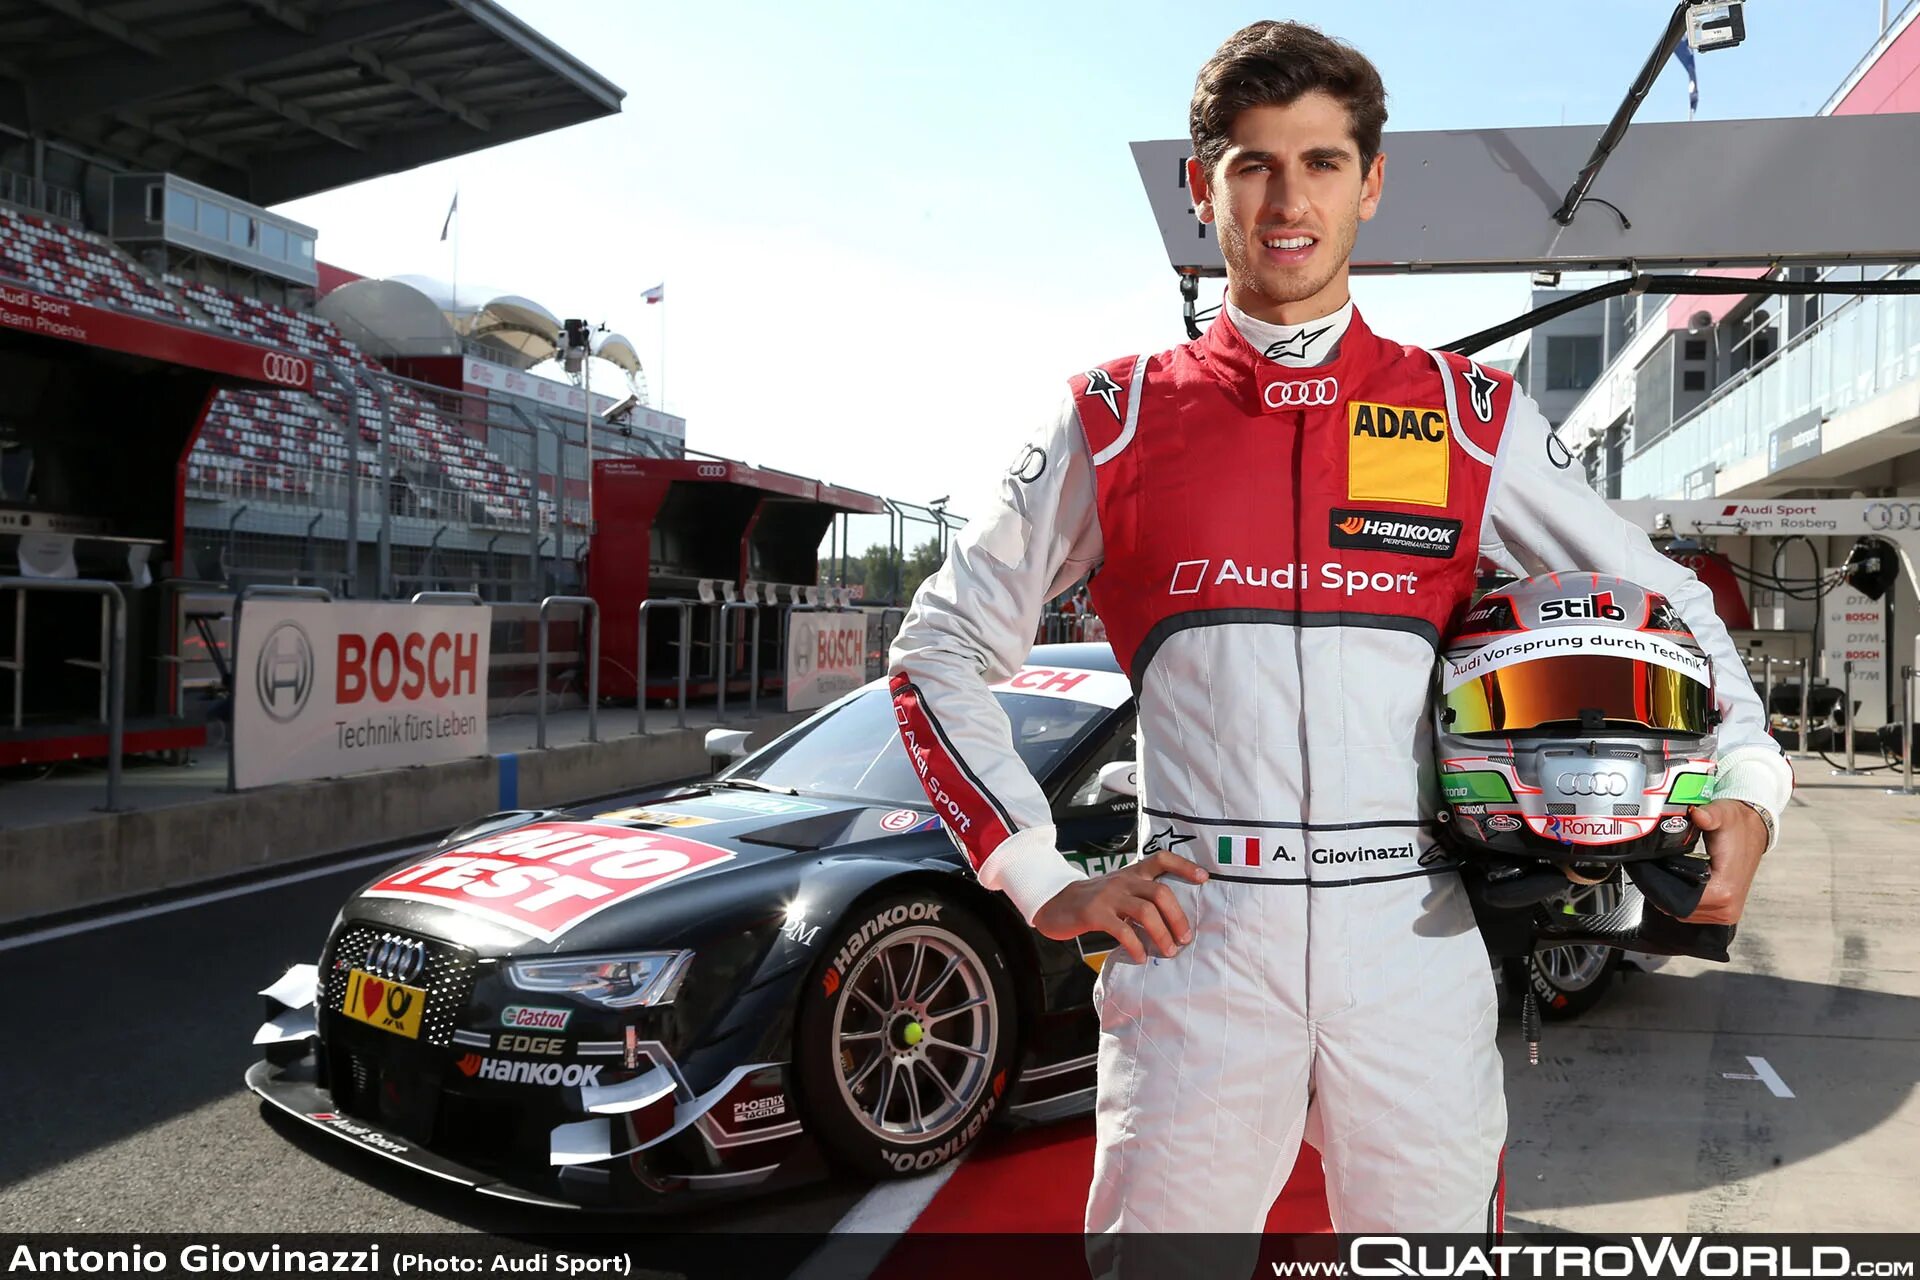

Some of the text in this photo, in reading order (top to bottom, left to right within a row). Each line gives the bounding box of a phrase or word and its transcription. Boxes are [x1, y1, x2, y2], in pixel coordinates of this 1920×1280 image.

[32, 295, 71, 317] Sport
[36, 316, 87, 340] Phoenix
[1353, 405, 1445, 442] ADAC
[1740, 504, 1816, 517] Audi Sport
[1781, 518, 1837, 529] Rosberg
[1215, 559, 1418, 596] Audi Sport
[1540, 591, 1625, 621] Stilo
[1845, 613, 1879, 622] BOSCH
[817, 629, 863, 669] BOSCH
[1847, 633, 1879, 643] DTM
[1452, 635, 1702, 678] Audi Vorsprung durch Technik
[1845, 651, 1879, 660] BOSCH
[336, 631, 478, 704] BOSCH
[1853, 671, 1879, 681] TM
[336, 711, 477, 750] Technik fürs Leben
[904, 731, 972, 833] Audi Sport
[1562, 819, 1622, 836] Ronzulli
[1272, 842, 1414, 865] A. Giovinazzi
[391, 857, 617, 913] TEST
[514, 1008, 567, 1029] Castrol
[497, 1034, 568, 1056] EDGE
[326, 1119, 408, 1153] Audi Sport
